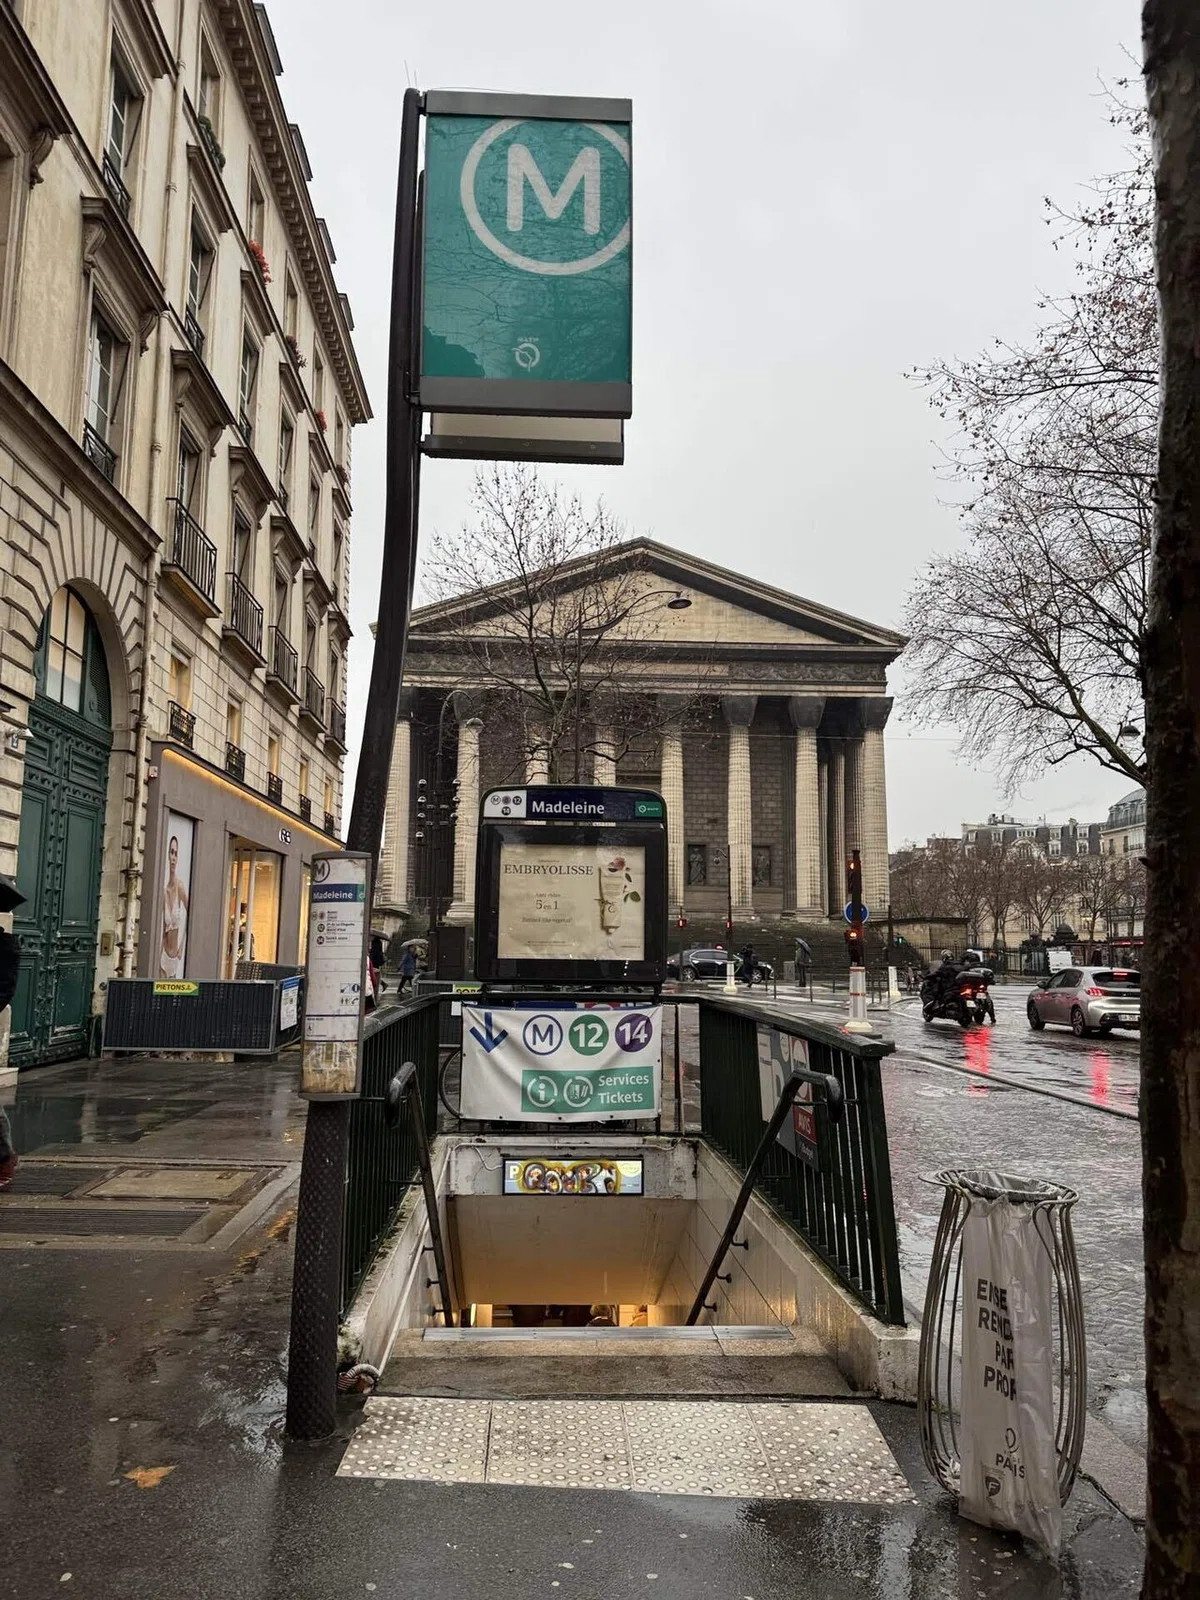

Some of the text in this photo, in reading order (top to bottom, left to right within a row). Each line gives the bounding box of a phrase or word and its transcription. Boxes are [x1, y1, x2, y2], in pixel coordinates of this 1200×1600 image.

[507, 143, 601, 235] M
[532, 801, 605, 815] Madeleine
[504, 864, 594, 876] EMBRYOLISSE
[313, 890, 353, 900] Madeleine
[535, 900, 543, 910] 5
[553, 900, 559, 910] 1
[156, 983, 186, 991] PIETONS
[533, 1022, 648, 1048] M 12 14
[598, 1073, 650, 1088] Services
[598, 1091, 644, 1104] Tickets
